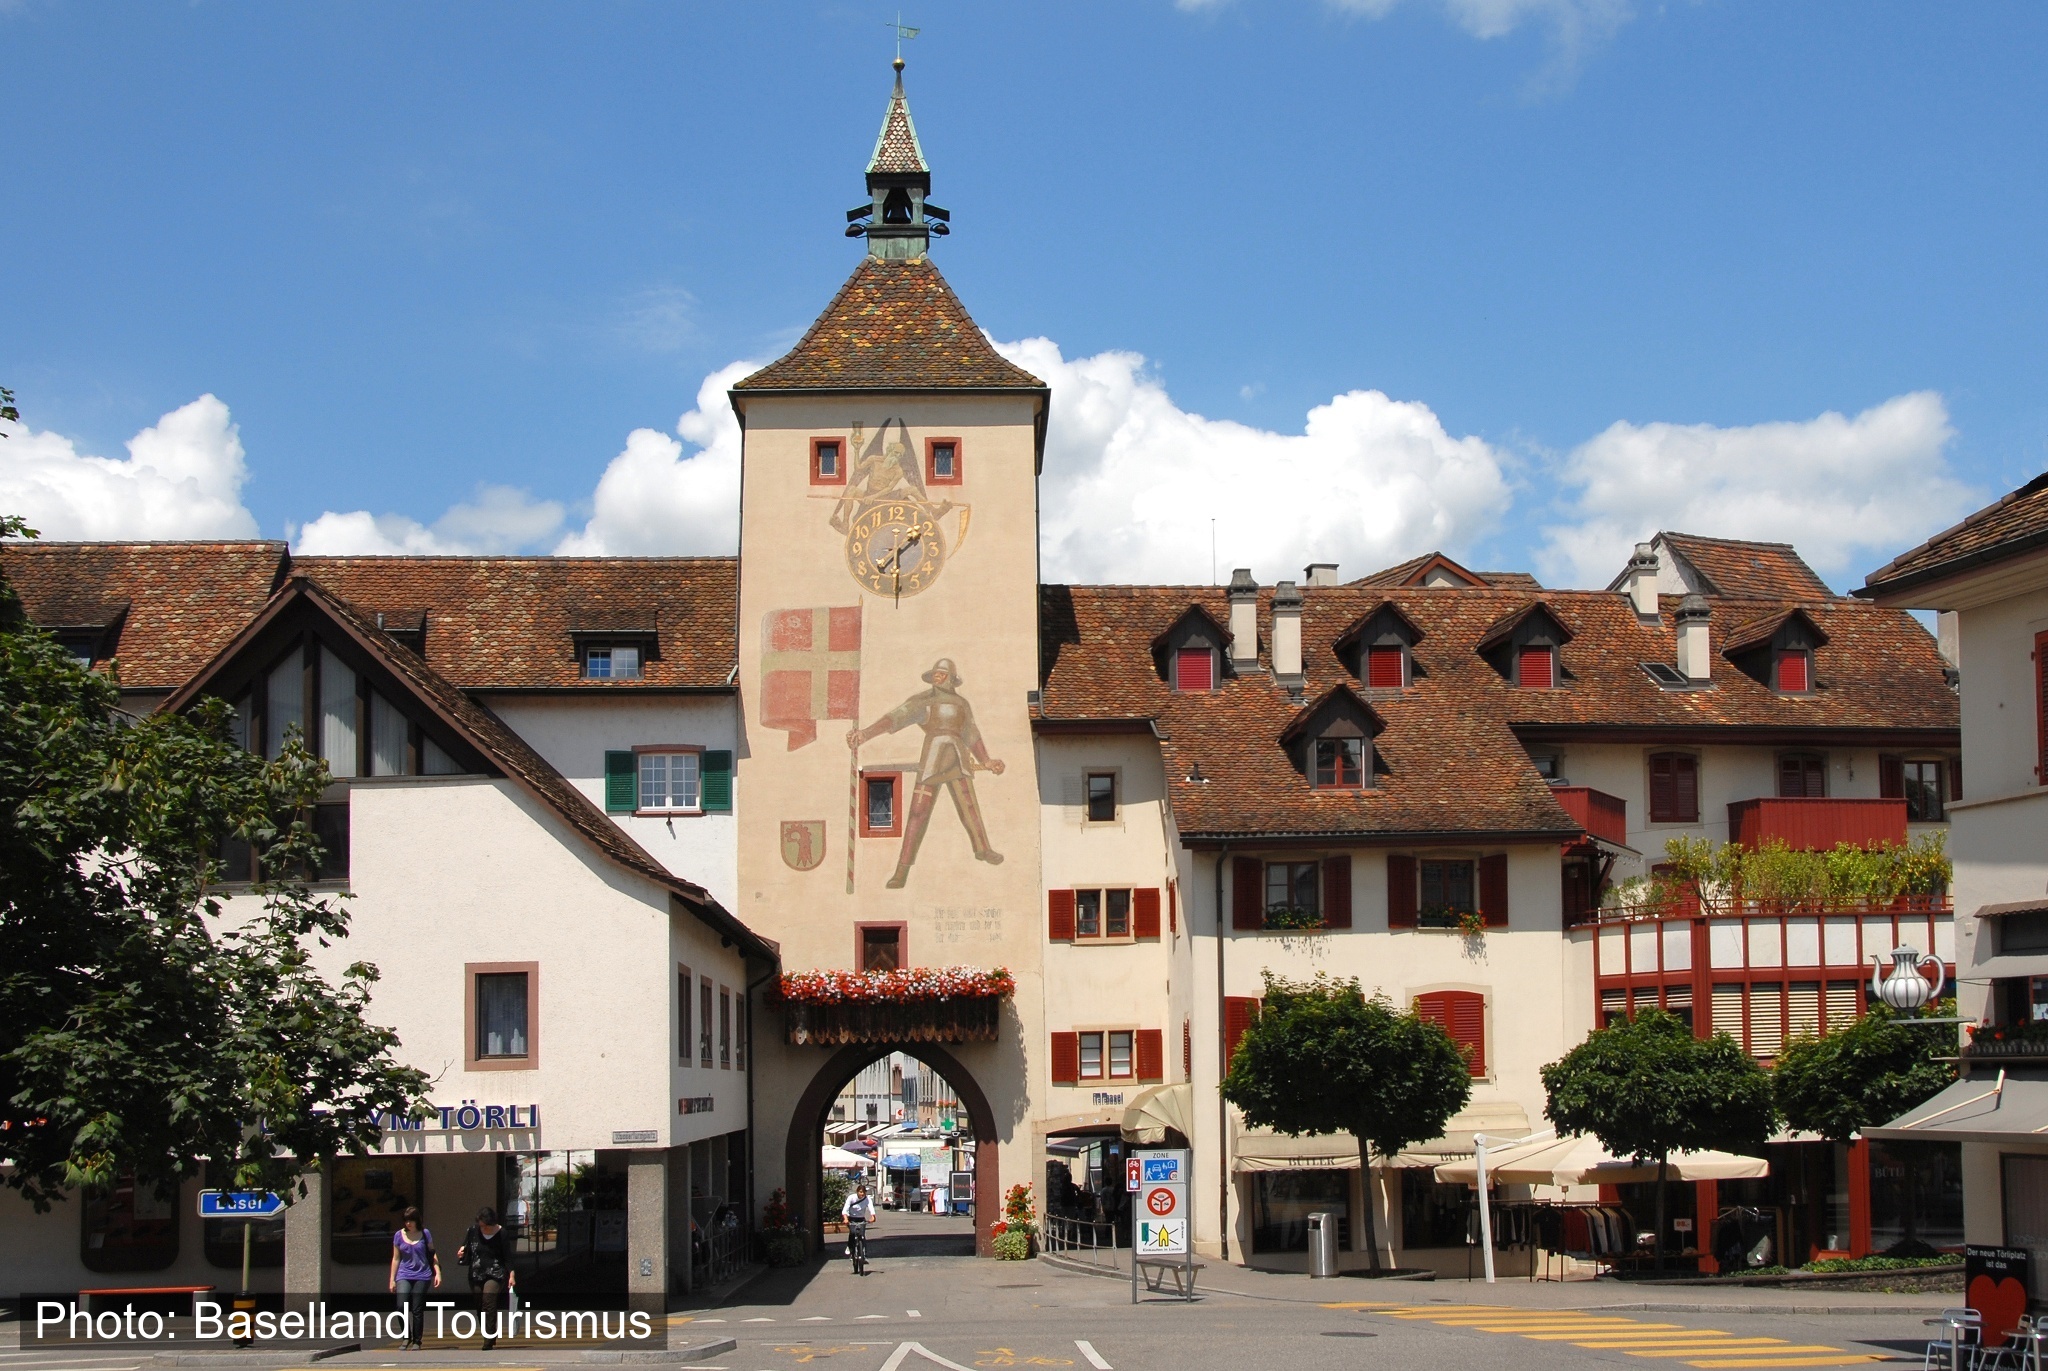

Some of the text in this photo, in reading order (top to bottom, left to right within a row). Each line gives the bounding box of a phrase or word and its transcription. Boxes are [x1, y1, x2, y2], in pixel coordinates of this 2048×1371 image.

[871, 511, 882, 528] 11
[888, 506, 905, 521] 12
[912, 510, 918, 525] 1
[855, 525, 869, 539] 10
[923, 521, 935, 537] 2
[853, 542, 862, 557] 9
[929, 542, 939, 556] 3
[858, 561, 867, 576] 8
[922, 561, 934, 576] 4
[870, 575, 881, 590] 7
[910, 574, 920, 589] 5
[437, 1099, 539, 1131] TÖRLI
[1288, 1155, 1336, 1167] BÜTLER
[1966, 1247, 1979, 1257] Der
[1979, 1249, 1996, 1258] neue
[1996, 1248, 2026, 1260] Törliplatz
[1985, 1259, 2007, 1269] ist das
